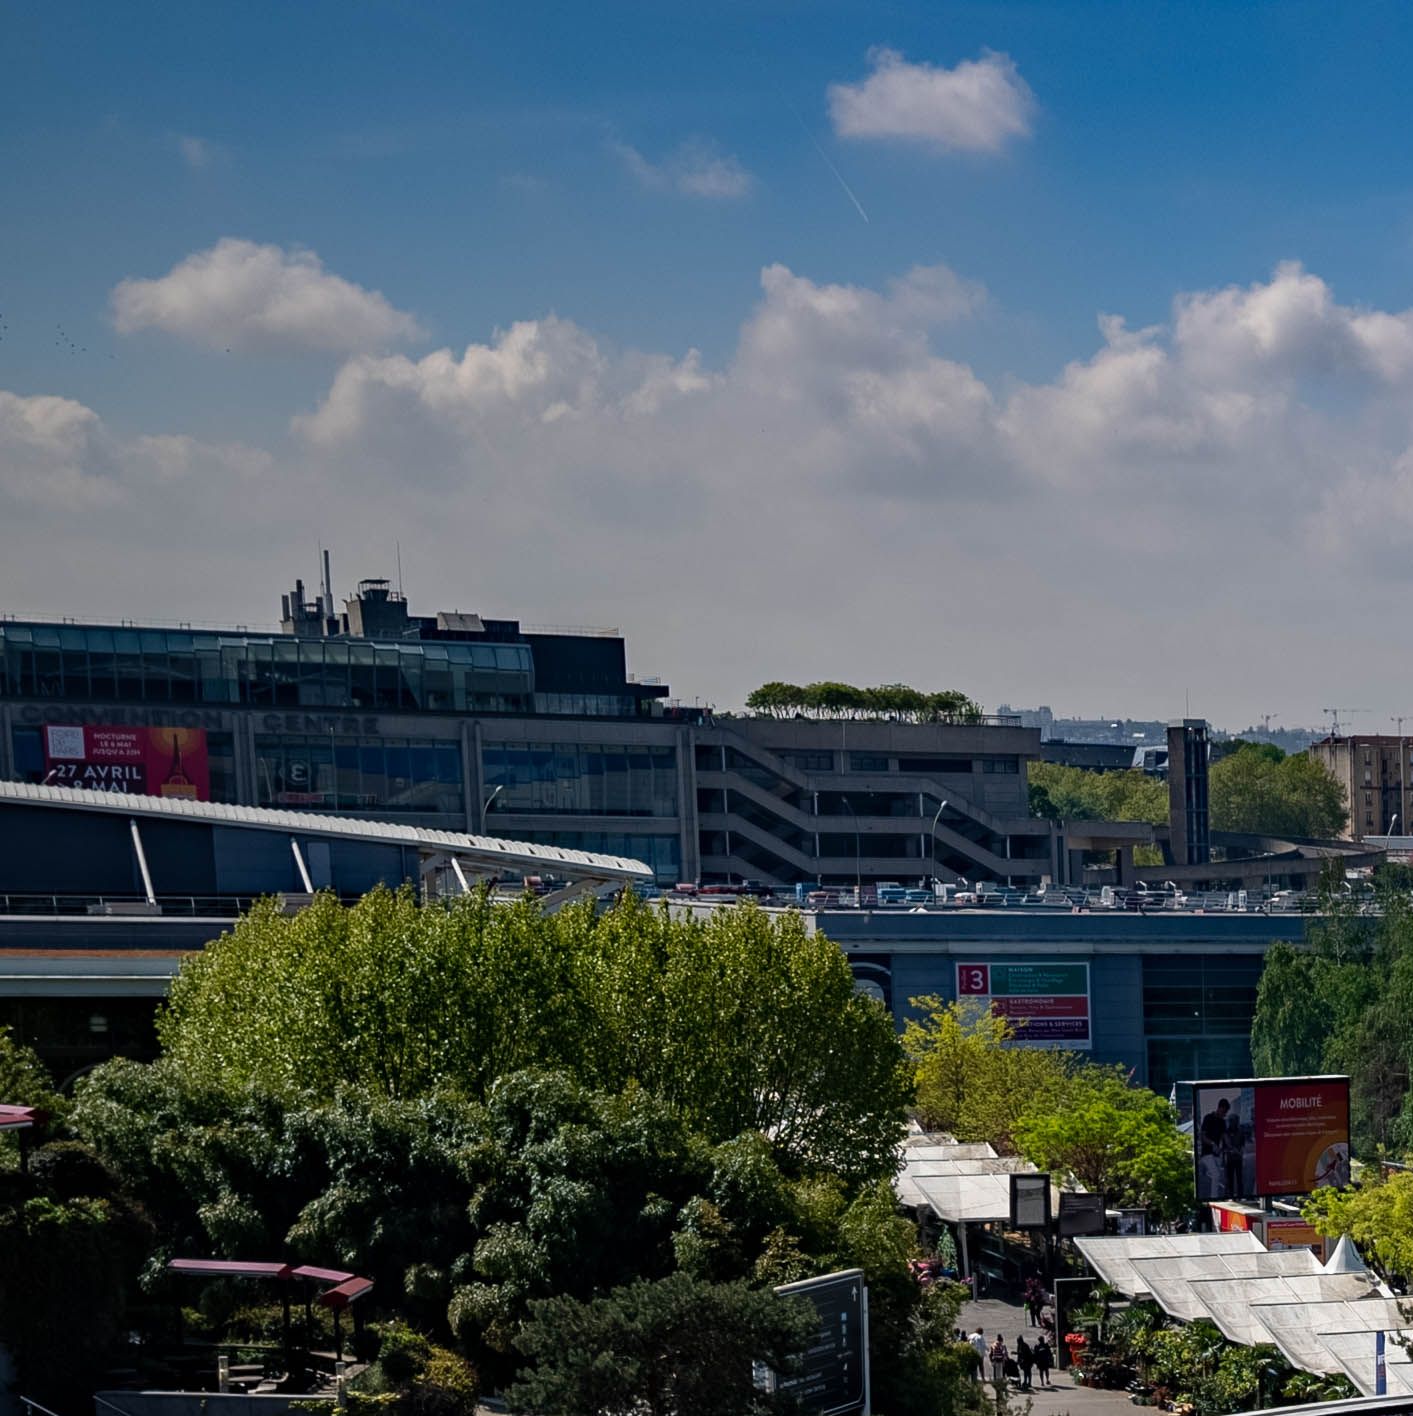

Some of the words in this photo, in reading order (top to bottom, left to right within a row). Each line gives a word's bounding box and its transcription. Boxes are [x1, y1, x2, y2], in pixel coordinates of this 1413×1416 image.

[21, 704, 223, 729] CONVENTION
[264, 713, 379, 734] CENTRE
[93, 733, 137, 741] NOCTURNE
[57, 765, 76, 778] 27
[84, 765, 141, 779] AVRIL
[970, 970, 984, 990] 3
[1280, 1094, 1323, 1109] MOBILITÉ
